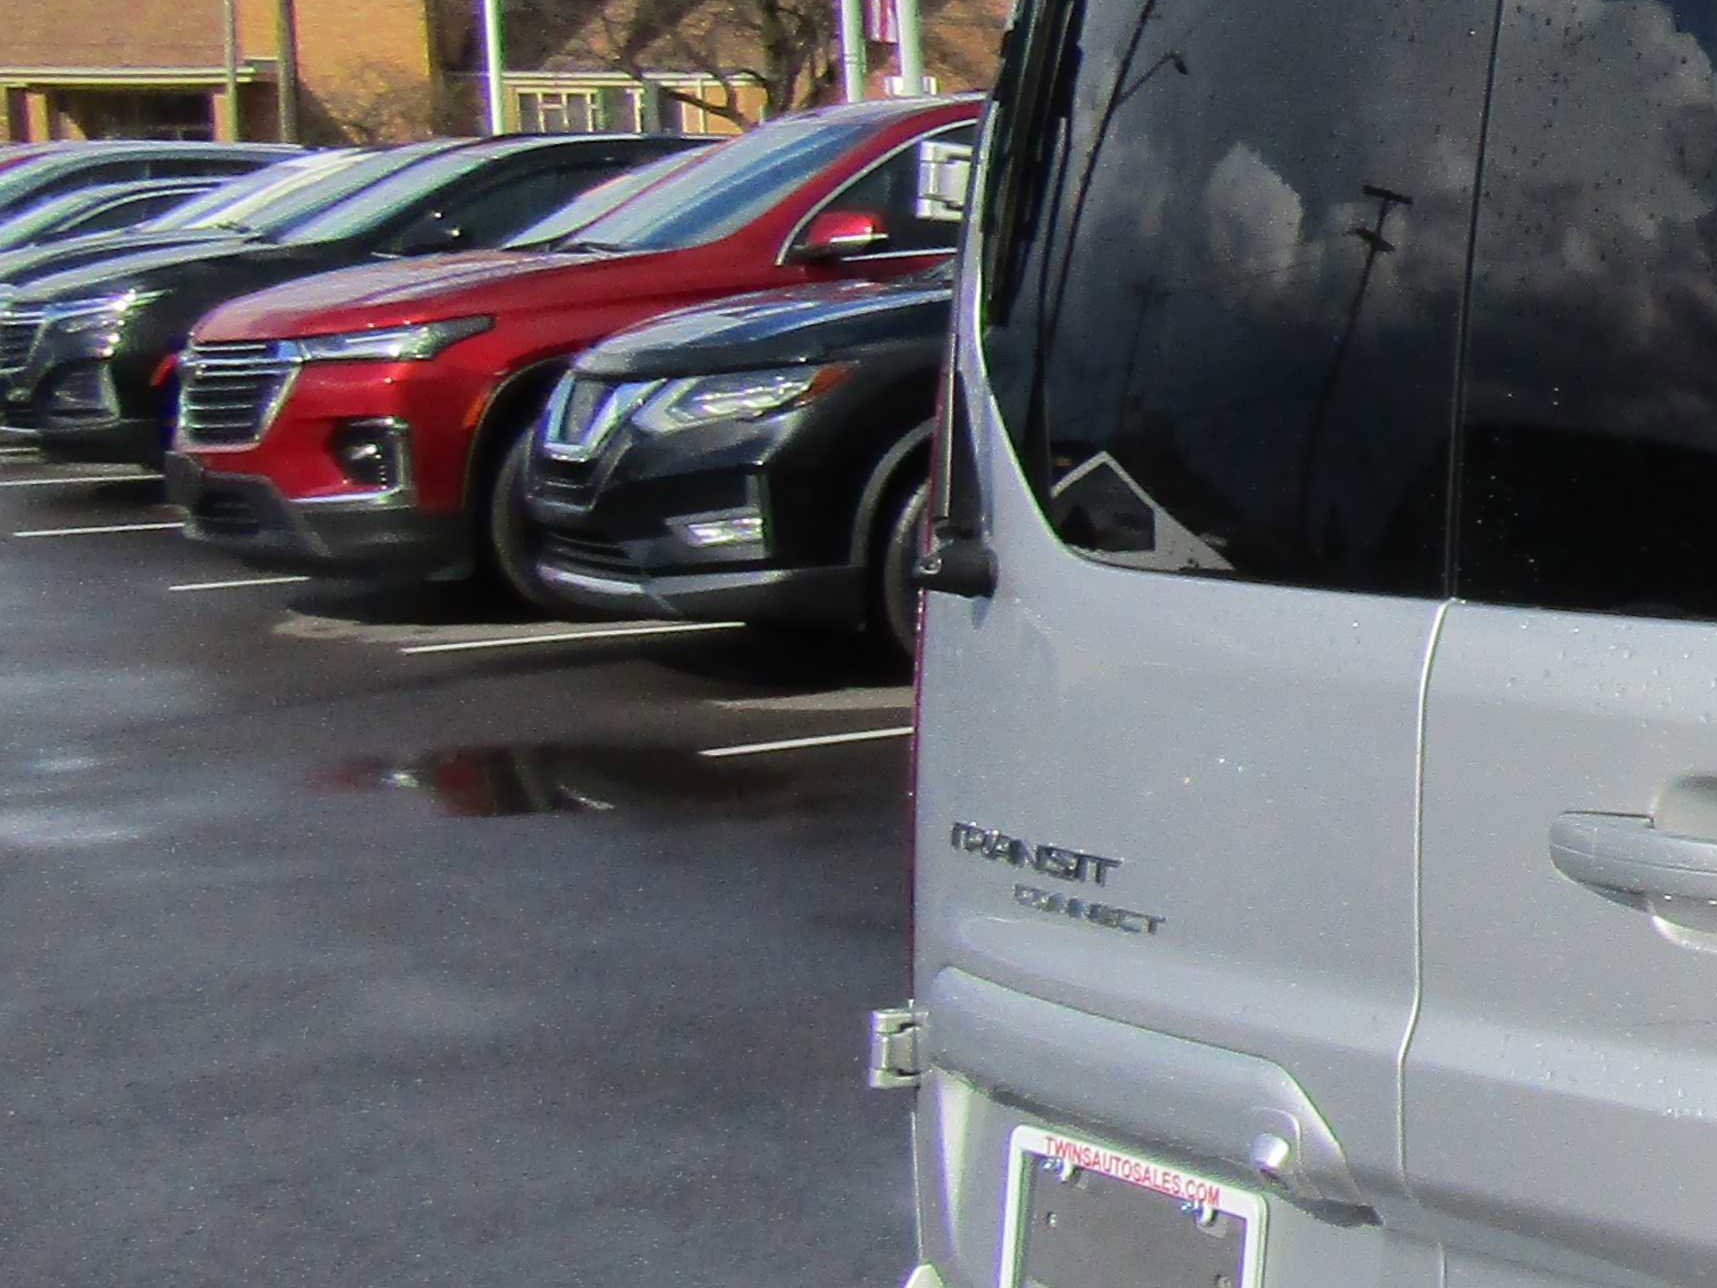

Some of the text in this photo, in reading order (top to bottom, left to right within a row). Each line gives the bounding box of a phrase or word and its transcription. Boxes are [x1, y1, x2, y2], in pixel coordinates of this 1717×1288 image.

[951, 821, 1123, 887] TRANSIT
[1013, 883, 1167, 935] CONNECT
[1045, 1136, 1220, 1207] TWINSAUTOSALES.COM
